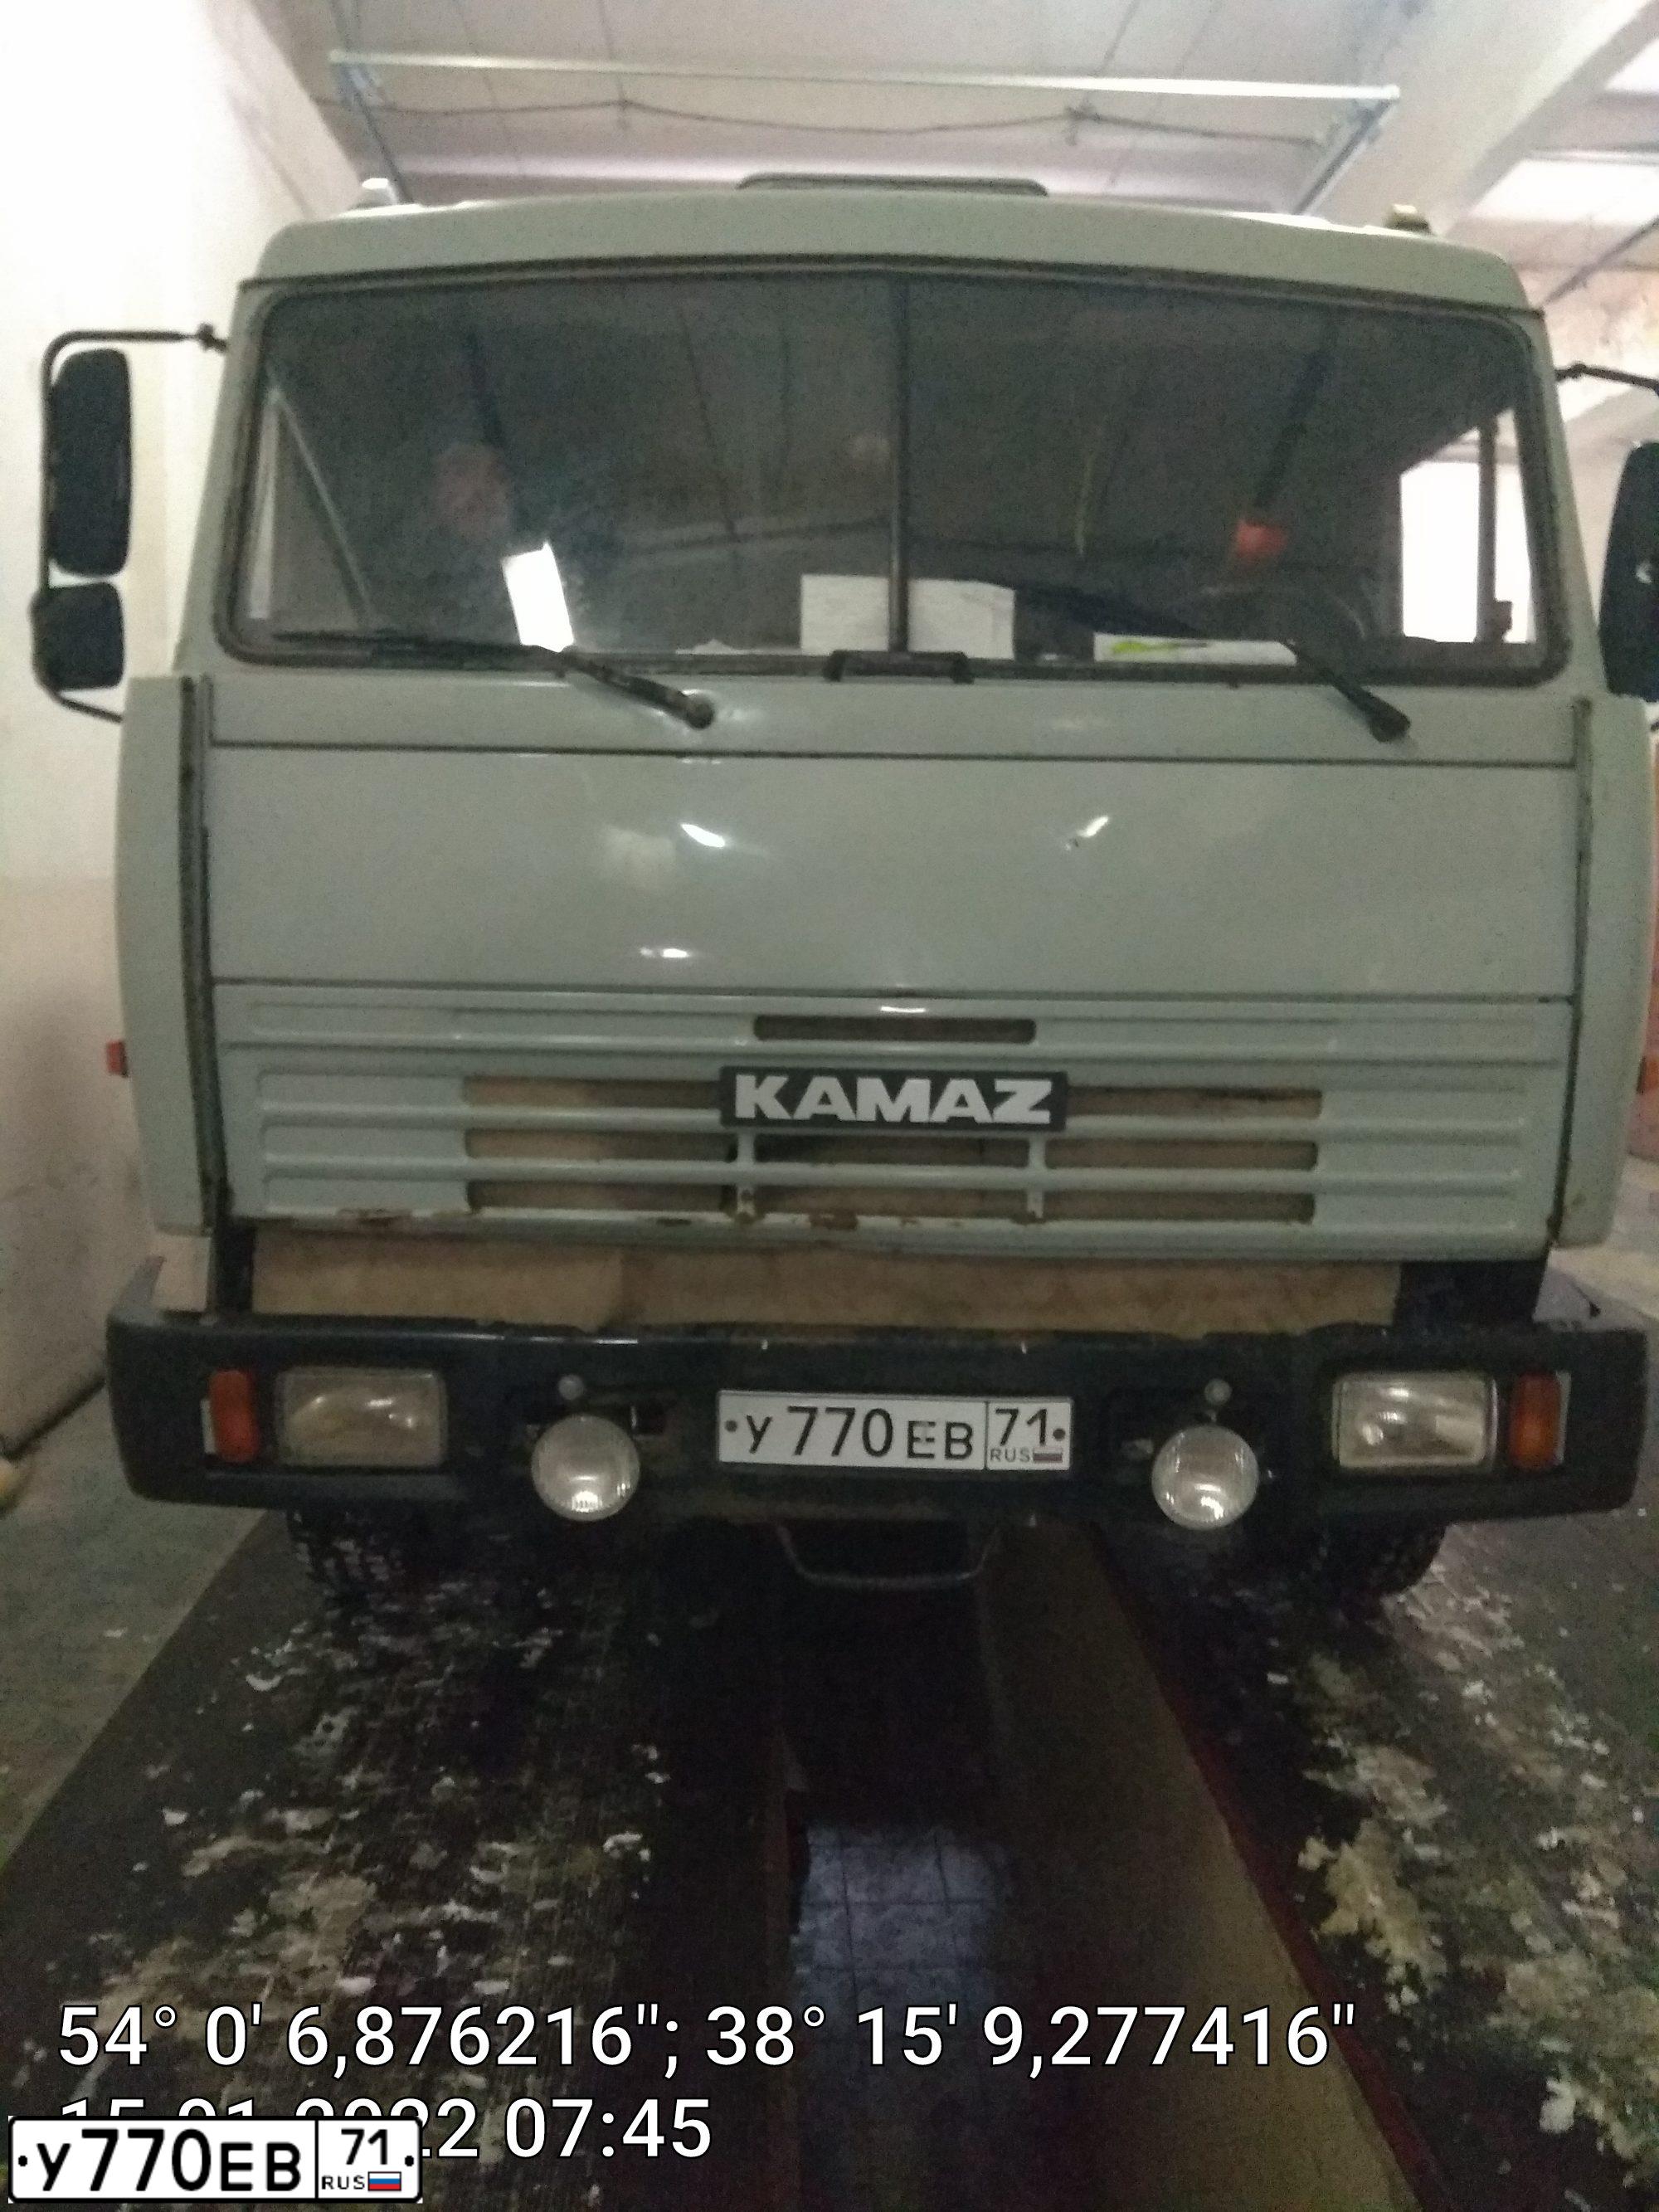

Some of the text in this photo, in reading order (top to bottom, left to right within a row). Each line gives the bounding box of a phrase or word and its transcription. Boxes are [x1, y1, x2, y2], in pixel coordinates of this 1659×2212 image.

[734, 1074, 1053, 1124] KAMAZ
[995, 1408, 1048, 1446] 71
[990, 1447, 1031, 1464] RUS
